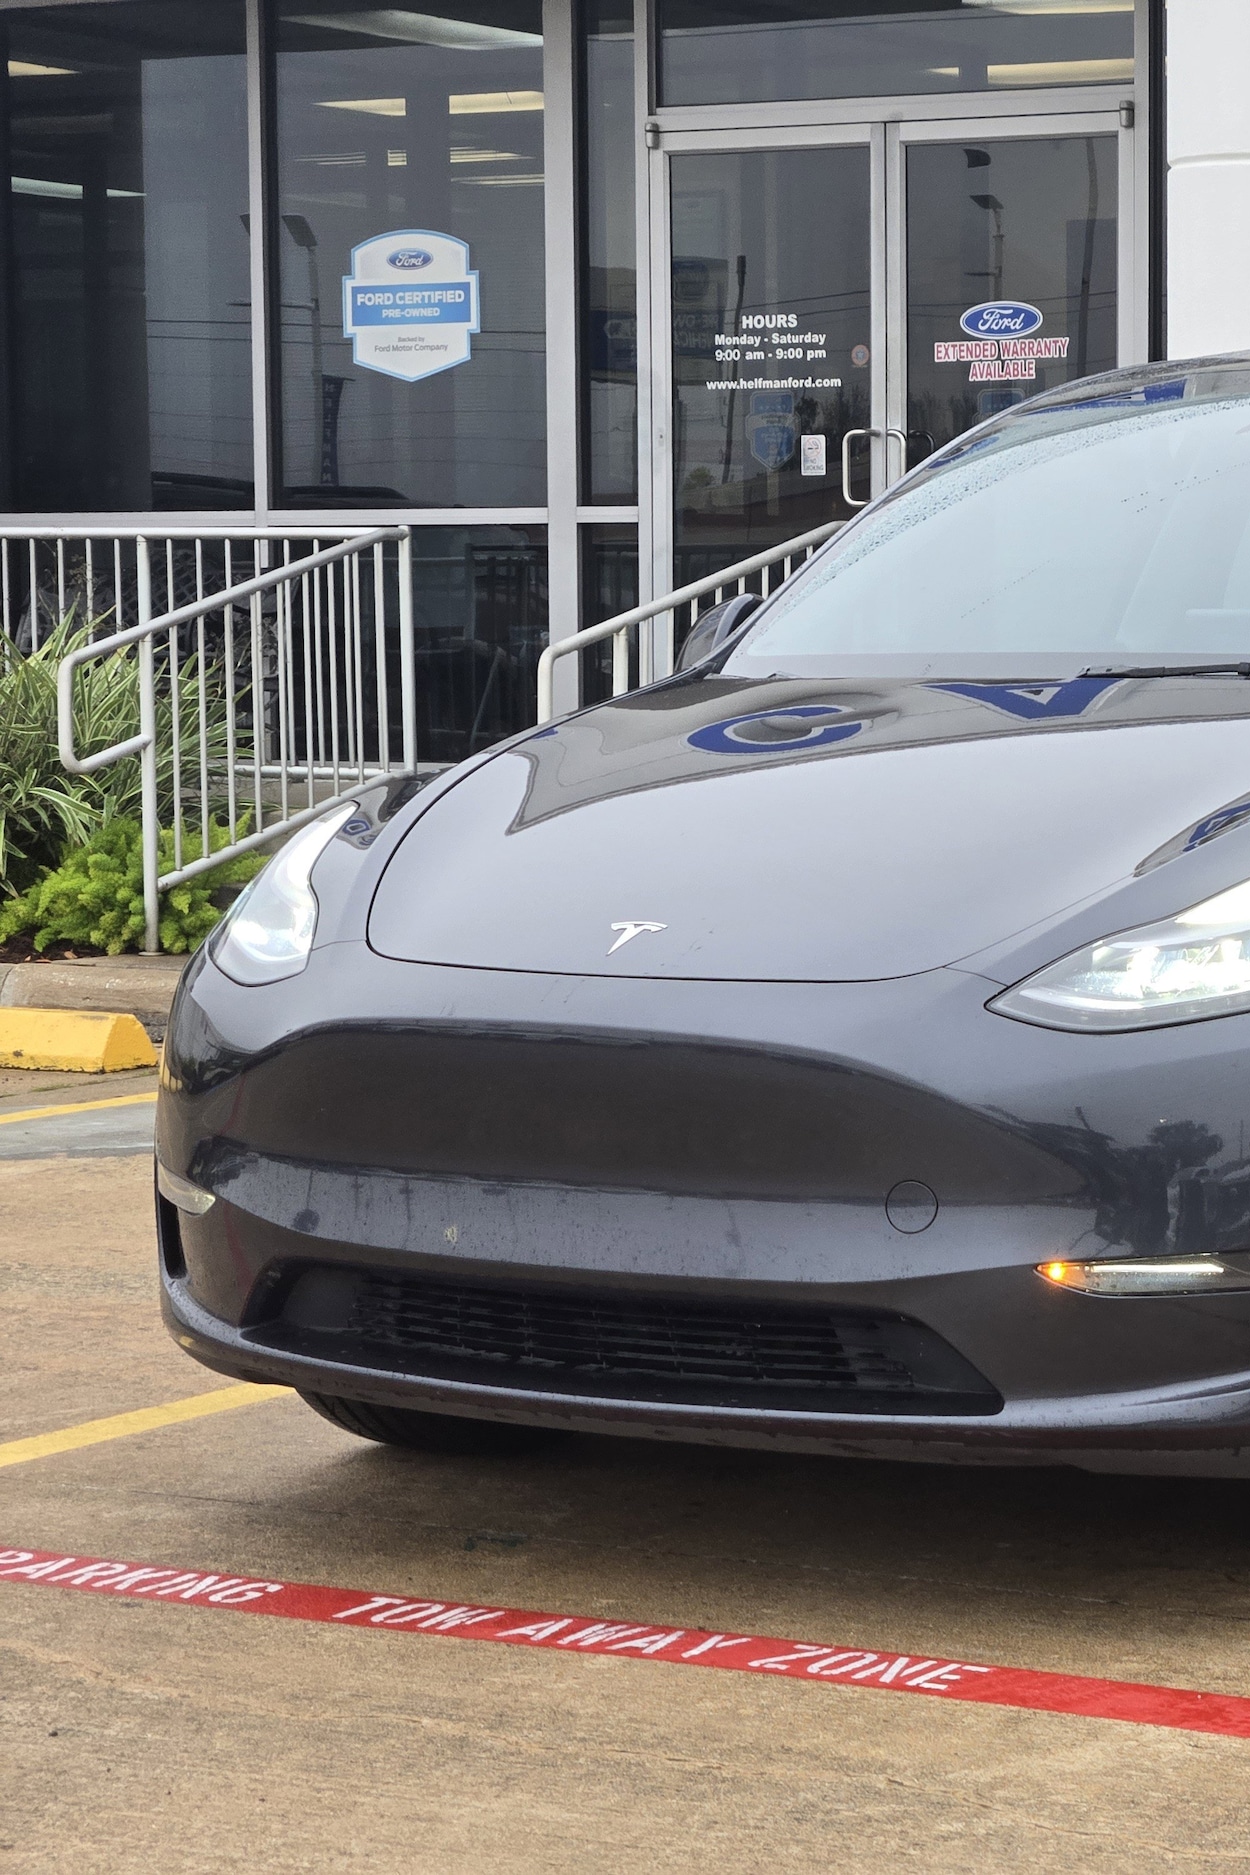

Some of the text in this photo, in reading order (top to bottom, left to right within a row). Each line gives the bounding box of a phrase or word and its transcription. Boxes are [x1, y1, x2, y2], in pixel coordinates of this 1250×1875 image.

[395, 251, 424, 266] Ford
[356, 290, 465, 306] FORD CERTIFIED
[382, 307, 440, 318] PRE-OWNED
[978, 308, 1025, 331] Ford
[741, 314, 798, 329] HOURS
[418, 336, 425, 344] by
[714, 334, 761, 347] Monday
[771, 332, 826, 345] Saturday
[391, 344, 413, 352] Motor
[414, 343, 448, 353] Company
[715, 348, 741, 361] 9:00
[745, 350, 765, 360] am
[775, 348, 804, 360] 9:00
[807, 348, 827, 361] pm
[934, 337, 1069, 362] EXTENDED WARRANTY
[969, 360, 1036, 382] AVAILABLE
[706, 376, 842, 390] www.helfmanford.com
[331, 1596, 505, 1630] TOW
[495, 1617, 751, 1659] AWAY
[748, 1644, 992, 1691] ZONE
